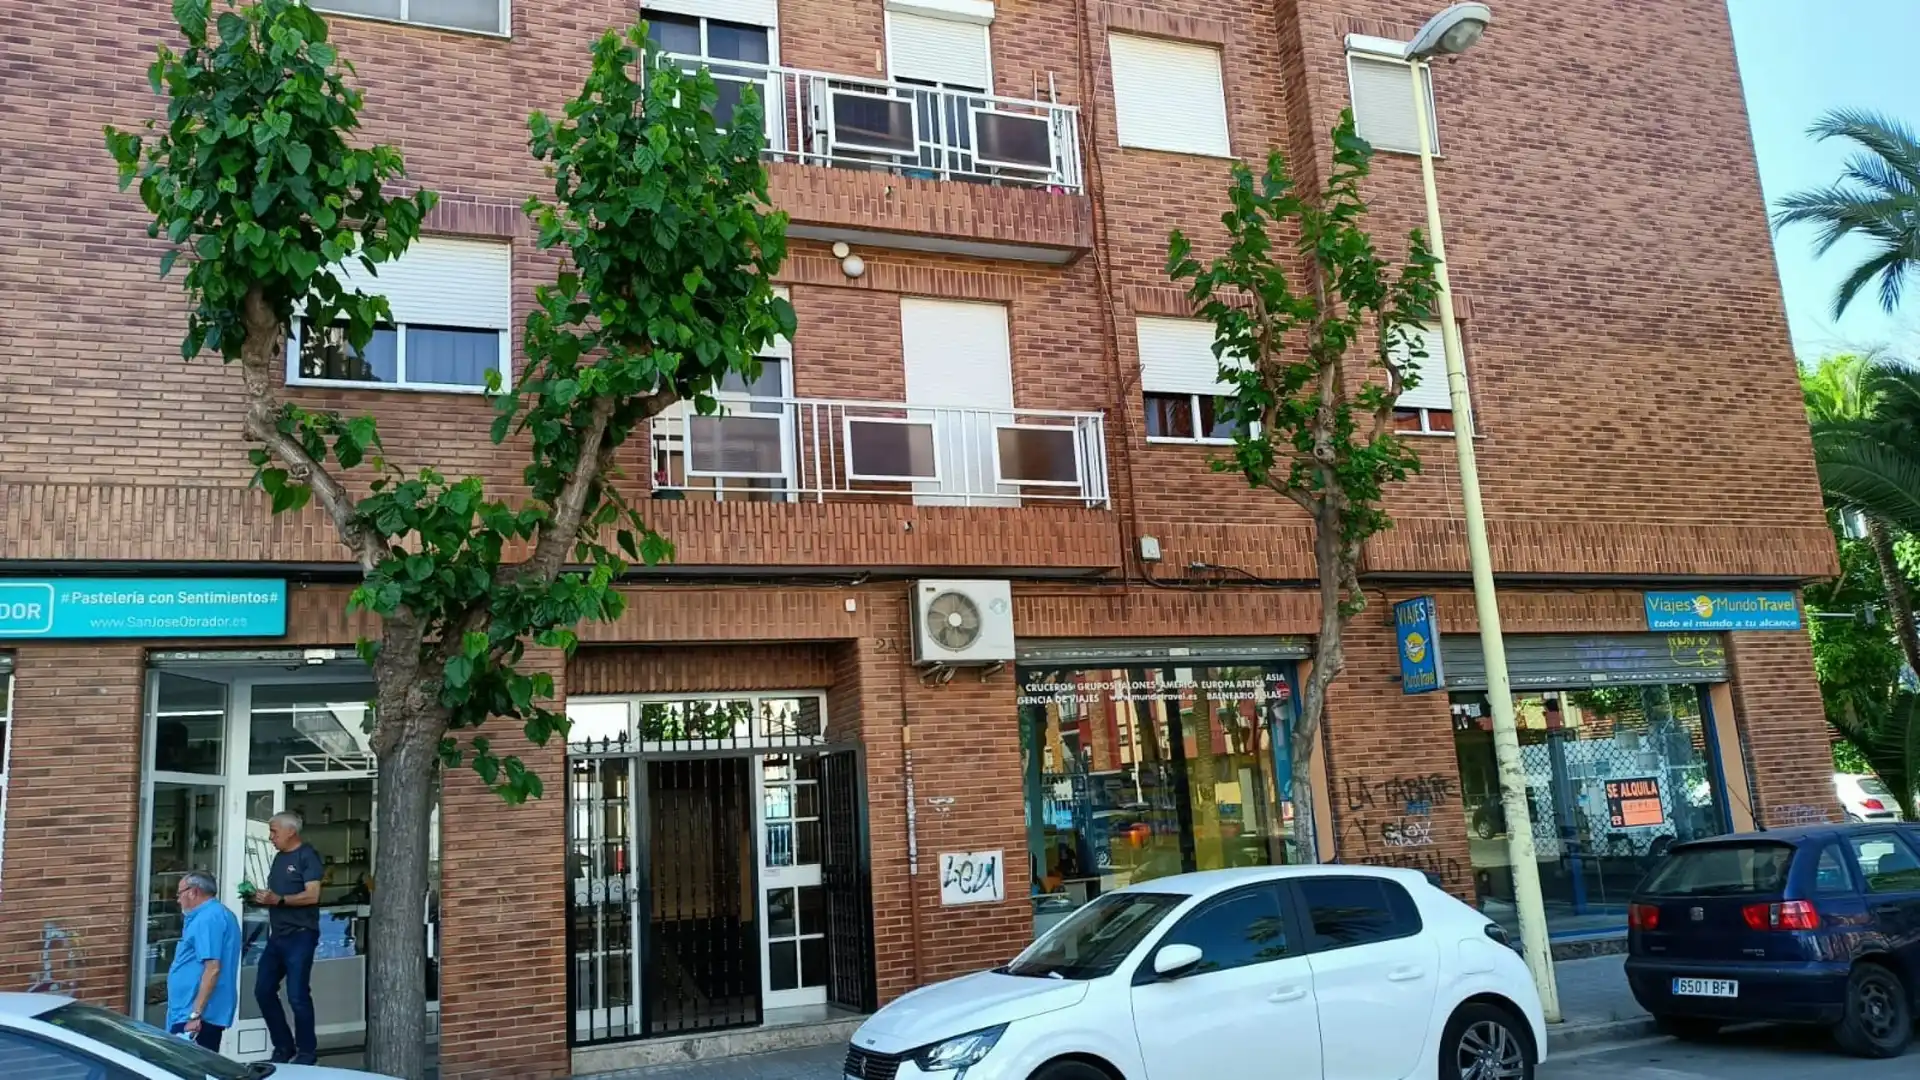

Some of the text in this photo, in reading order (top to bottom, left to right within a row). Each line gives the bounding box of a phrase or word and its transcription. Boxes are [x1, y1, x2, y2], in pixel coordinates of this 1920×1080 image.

[149, 593, 174, 604] con
[178, 591, 278, 604] Sentimientos#
[1397, 602, 1426, 626] VIAJES
[1648, 598, 1691, 615] Viajes
[90, 616, 248, 628] www.SanJoseObrador.es
[1654, 619, 1680, 628] todo
[1683, 619, 1692, 628] el
[1695, 619, 1733, 628] mundo
[1745, 620, 1757, 628] tu
[1759, 618, 1797, 628] alcance
[1025, 683, 1074, 692] CRUCEROS
[1077, 681, 1115, 691] GRUPOS
[1160, 680, 1198, 690] AMERICA
[1201, 680, 1235, 690] EUROPA
[1236, 679, 1266, 690] AFRICA
[1265, 673, 1286, 682] ASIA
[1055, 694, 1068, 704] DE
[1071, 693, 1100, 704] VIAJES
[1206, 690, 1258, 701] BALNEARIOS
[1606, 780, 1658, 798] SE ALQUILA
[1680, 980, 1736, 995] 6501 BFW
